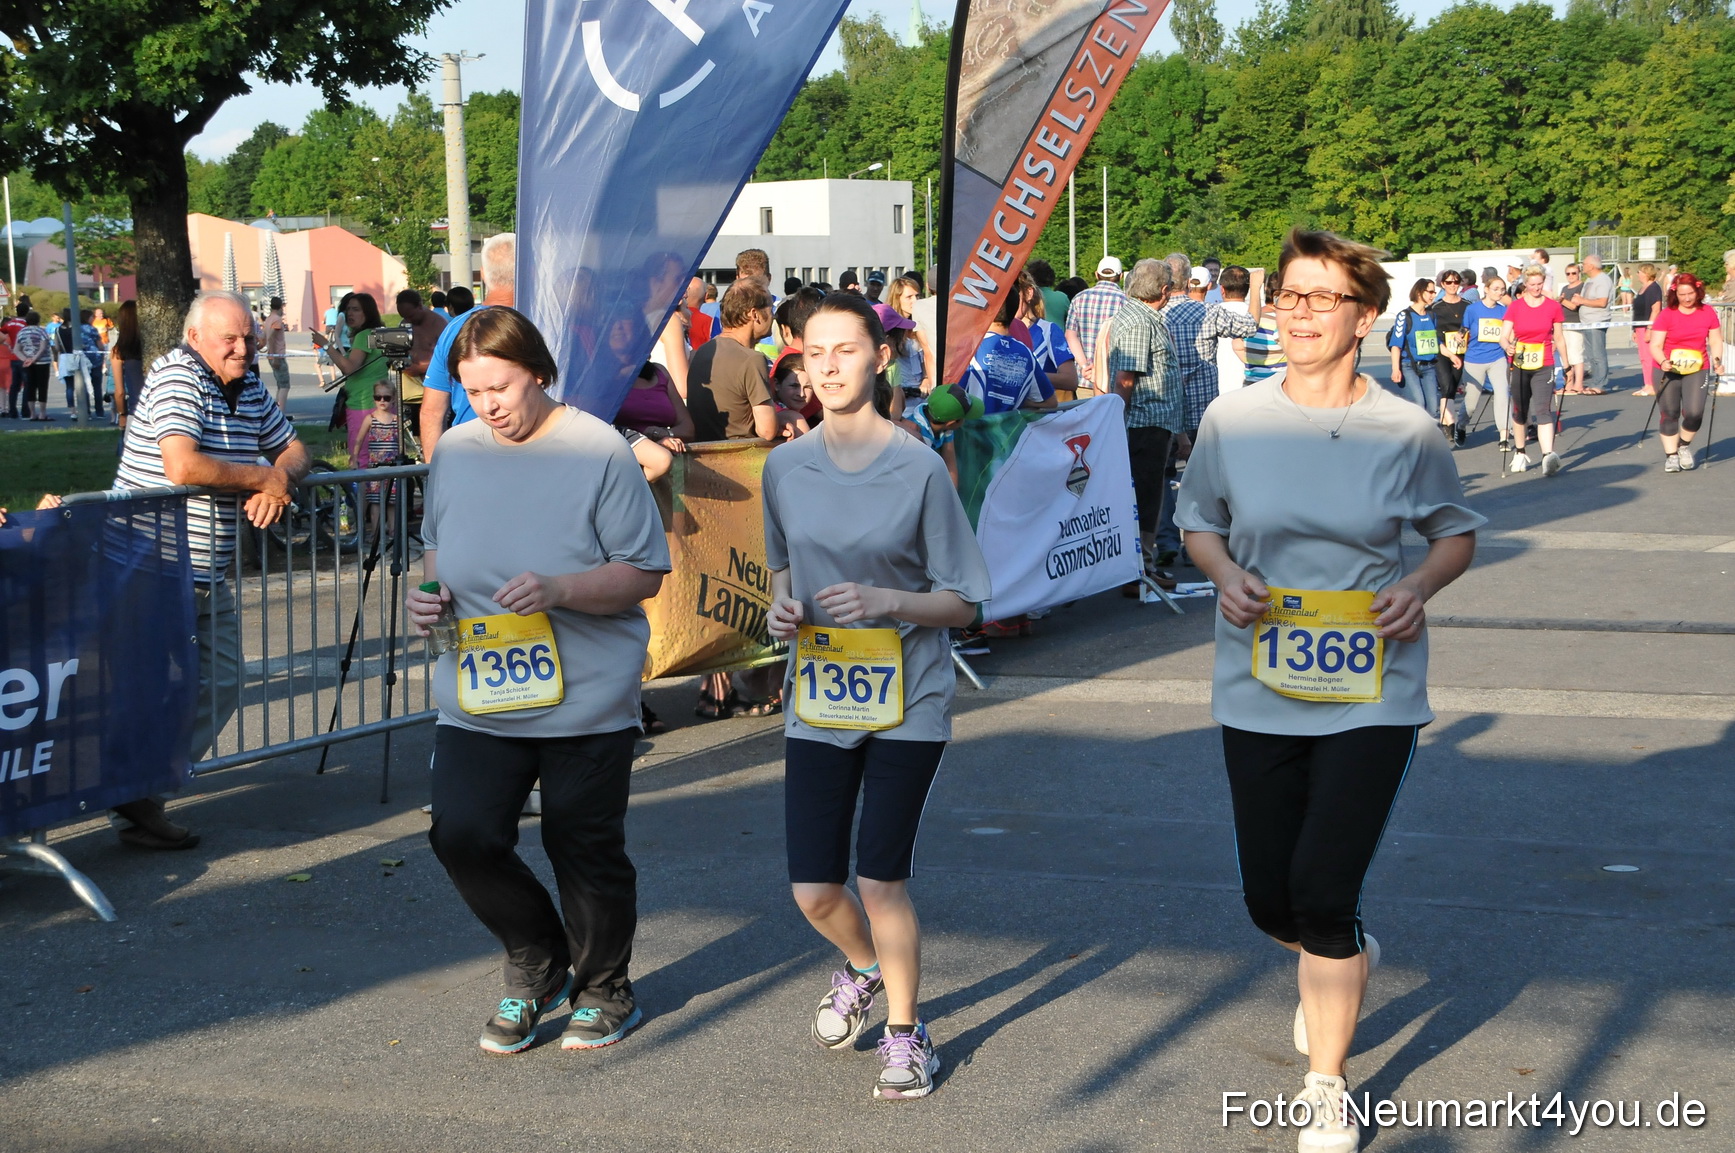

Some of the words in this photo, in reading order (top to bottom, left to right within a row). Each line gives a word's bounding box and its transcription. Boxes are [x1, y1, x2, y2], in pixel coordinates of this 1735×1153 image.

[1482, 326, 1501, 337] 640
[1420, 338, 1436, 349] 716
[1517, 352, 1539, 364] 418
[1675, 359, 1698, 369] 417
[1274, 606, 1319, 618] firmenlauf
[1260, 616, 1296, 629] walken
[466, 630, 500, 644] firmenlauf
[809, 643, 843, 653] firmenlauf
[1259, 626, 1375, 674] 1368
[460, 643, 556, 691] 1366
[800, 661, 896, 705] 1367
[1288, 673, 1317, 683] Hermine
[1317, 676, 1344, 684] Bogner
[490, 687, 506, 696] Tanja
[506, 686, 531, 695] Schicker
[1280, 682, 1322, 692] Steuerkanzlei
[0, 658, 79, 731] er
[481, 695, 516, 705] Steuerkanzlei
[523, 692, 539, 700] Müller
[828, 703, 851, 712] Corinna
[851, 705, 870, 713] Martin
[819, 712, 854, 720] Steuerkanzlei
[861, 714, 878, 722] Müller
